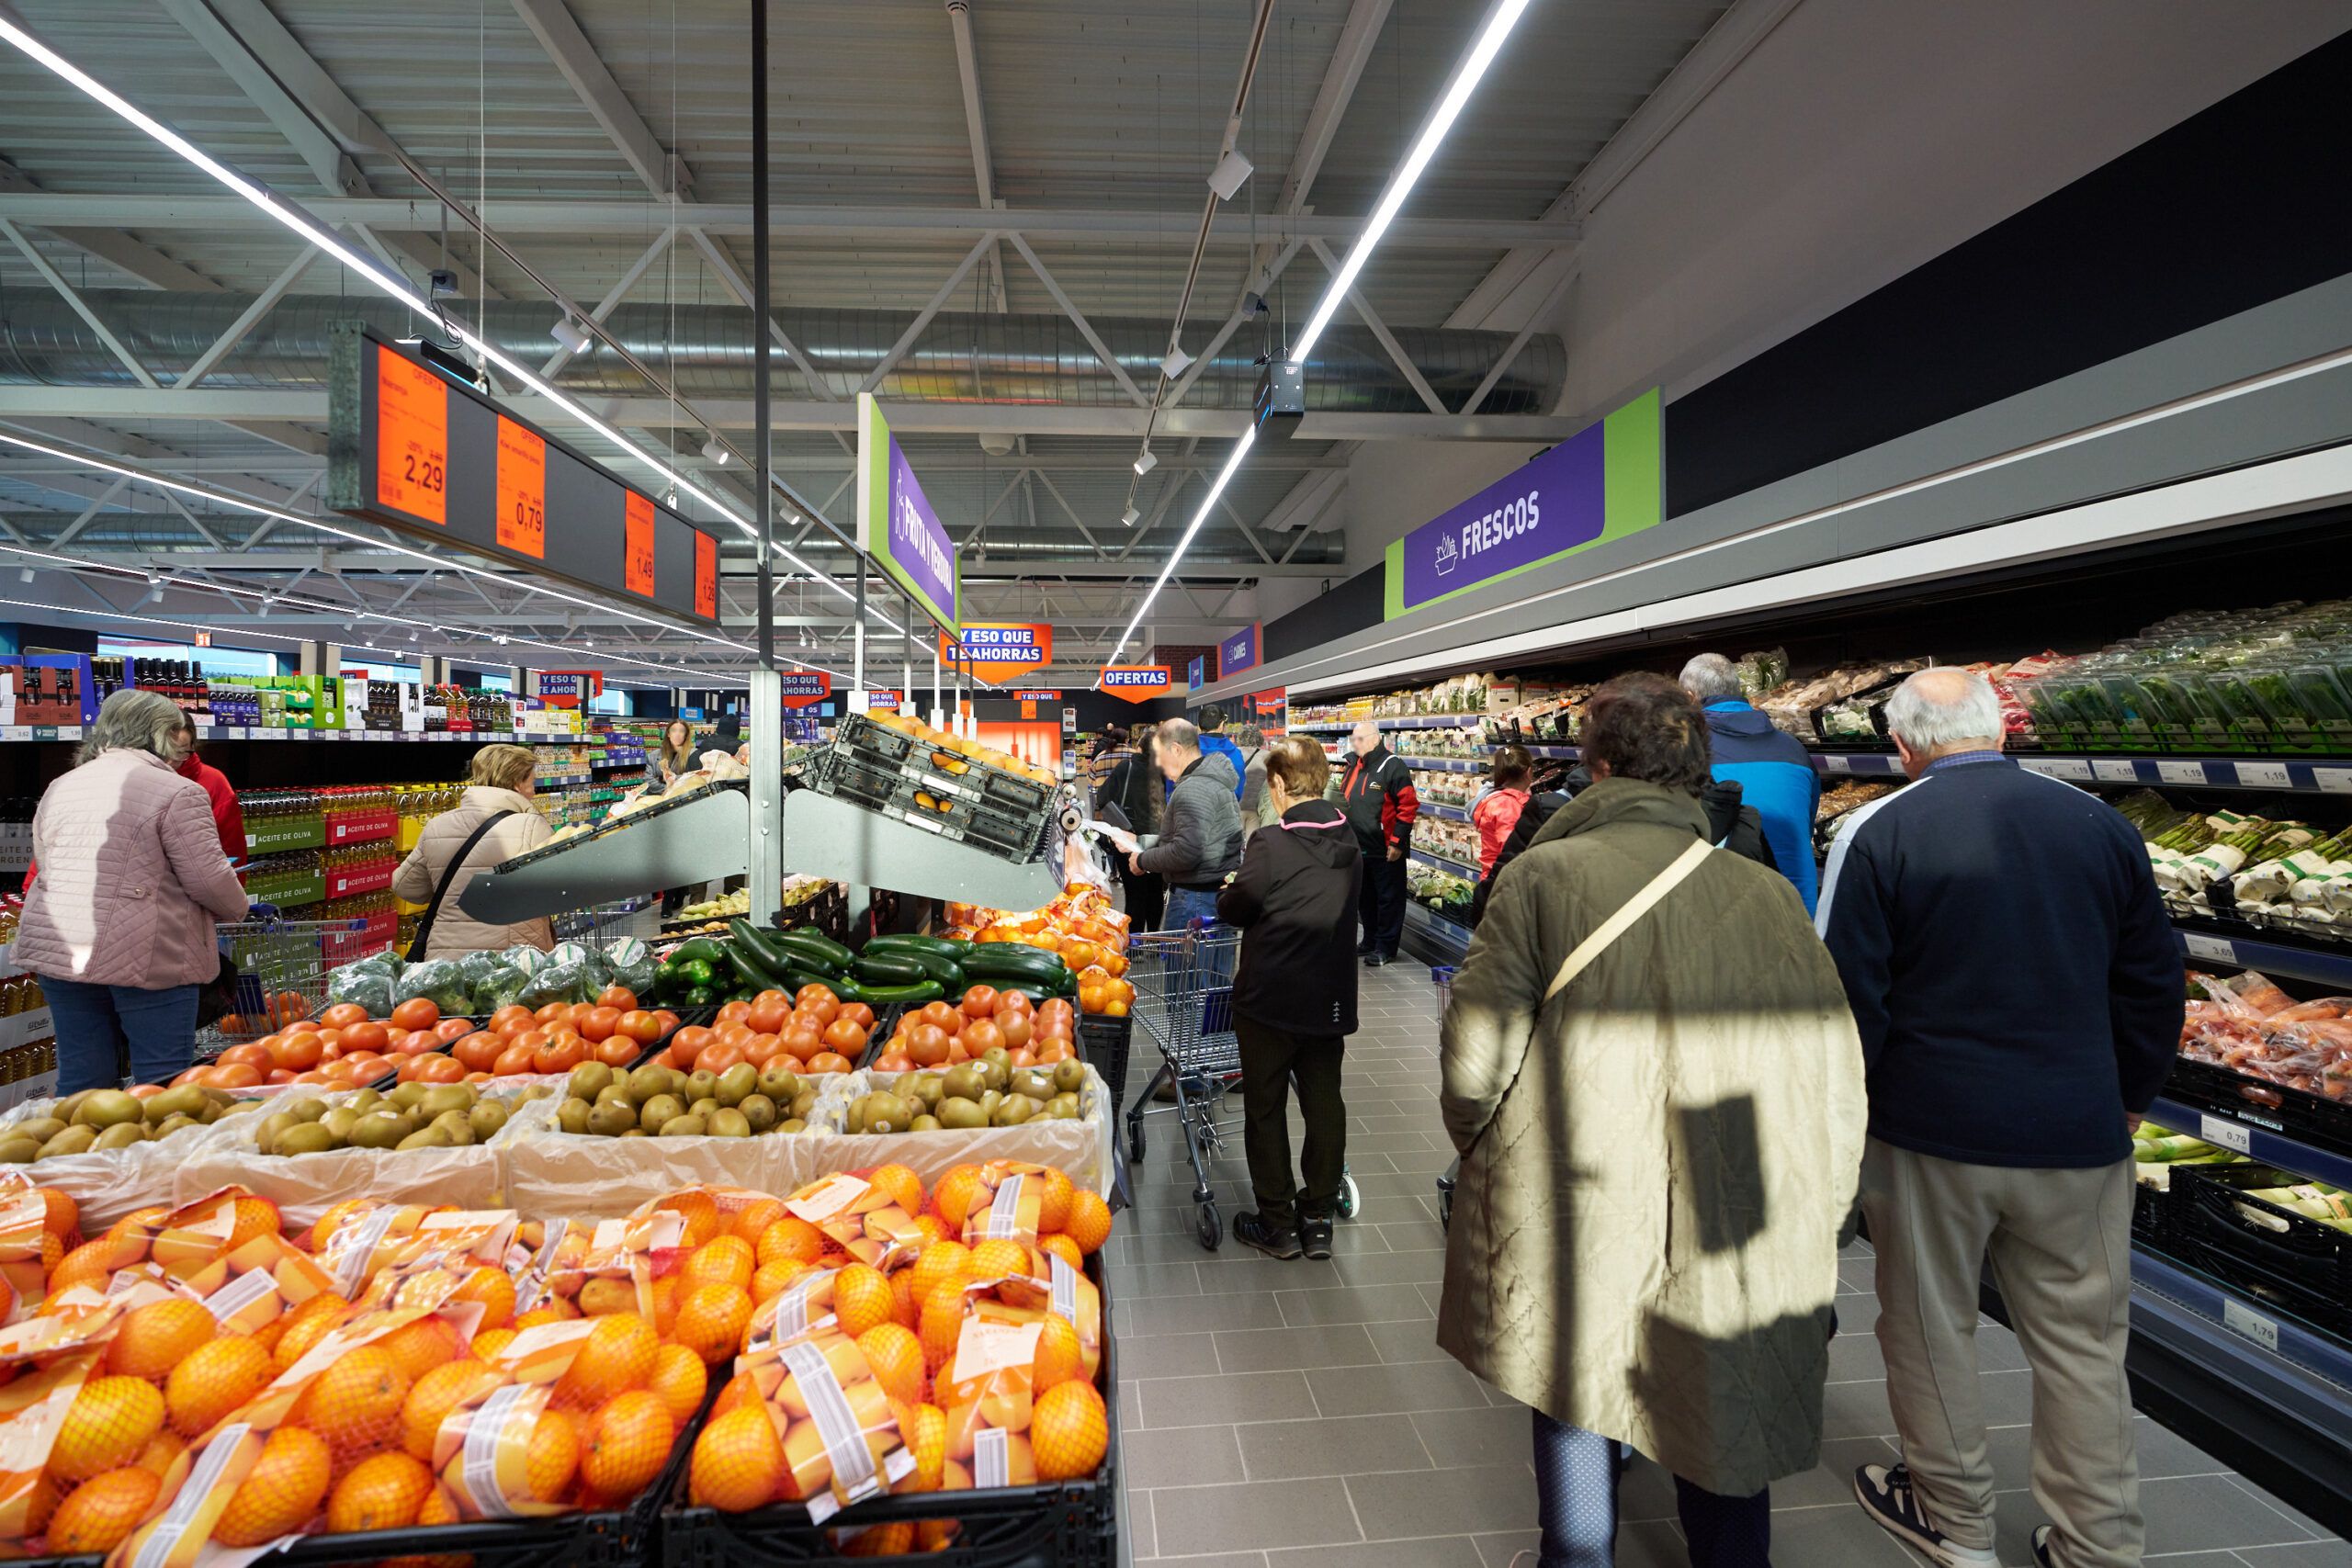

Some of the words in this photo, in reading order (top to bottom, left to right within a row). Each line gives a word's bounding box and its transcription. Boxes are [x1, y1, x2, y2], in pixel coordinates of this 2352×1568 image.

[405, 454, 443, 493] 2,29
[516, 502, 542, 533] 0,79
[905, 494, 926, 562] FRUTA
[1462, 491, 1540, 559] FRESCOS
[637, 557, 652, 579] 1,49
[960, 630, 967, 641] Y
[971, 630, 1000, 643] ESO
[1002, 631, 1032, 644] QUE
[971, 648, 1040, 660] AHORRAS
[550, 675, 568, 683] ESO
[799, 676, 818, 684] QUE
[1105, 671, 1166, 684] OFERTAS
[2073, 766, 2088, 775] 1,19
[2117, 767, 2133, 776] 1,19
[2183, 768, 2202, 778] 1,19
[2264, 771, 2286, 781] 1,19
[347, 825, 365, 833] ACEITE
[257, 833, 281, 843] ACEITE
[283, 832, 291, 840] DE
[293, 830, 311, 839] OLIVA
[348, 877, 366, 886] ACEITE
[375, 873, 389, 881] OLIVA
[259, 892, 283, 902] ACEITE
[294, 887, 311, 896] OLIVA
[373, 922, 388, 931] OLIVA
[2212, 946, 2233, 957] 3,69
[2227, 1131, 2247, 1145] 0,79
[2252, 1322, 2275, 1341] 1,79
